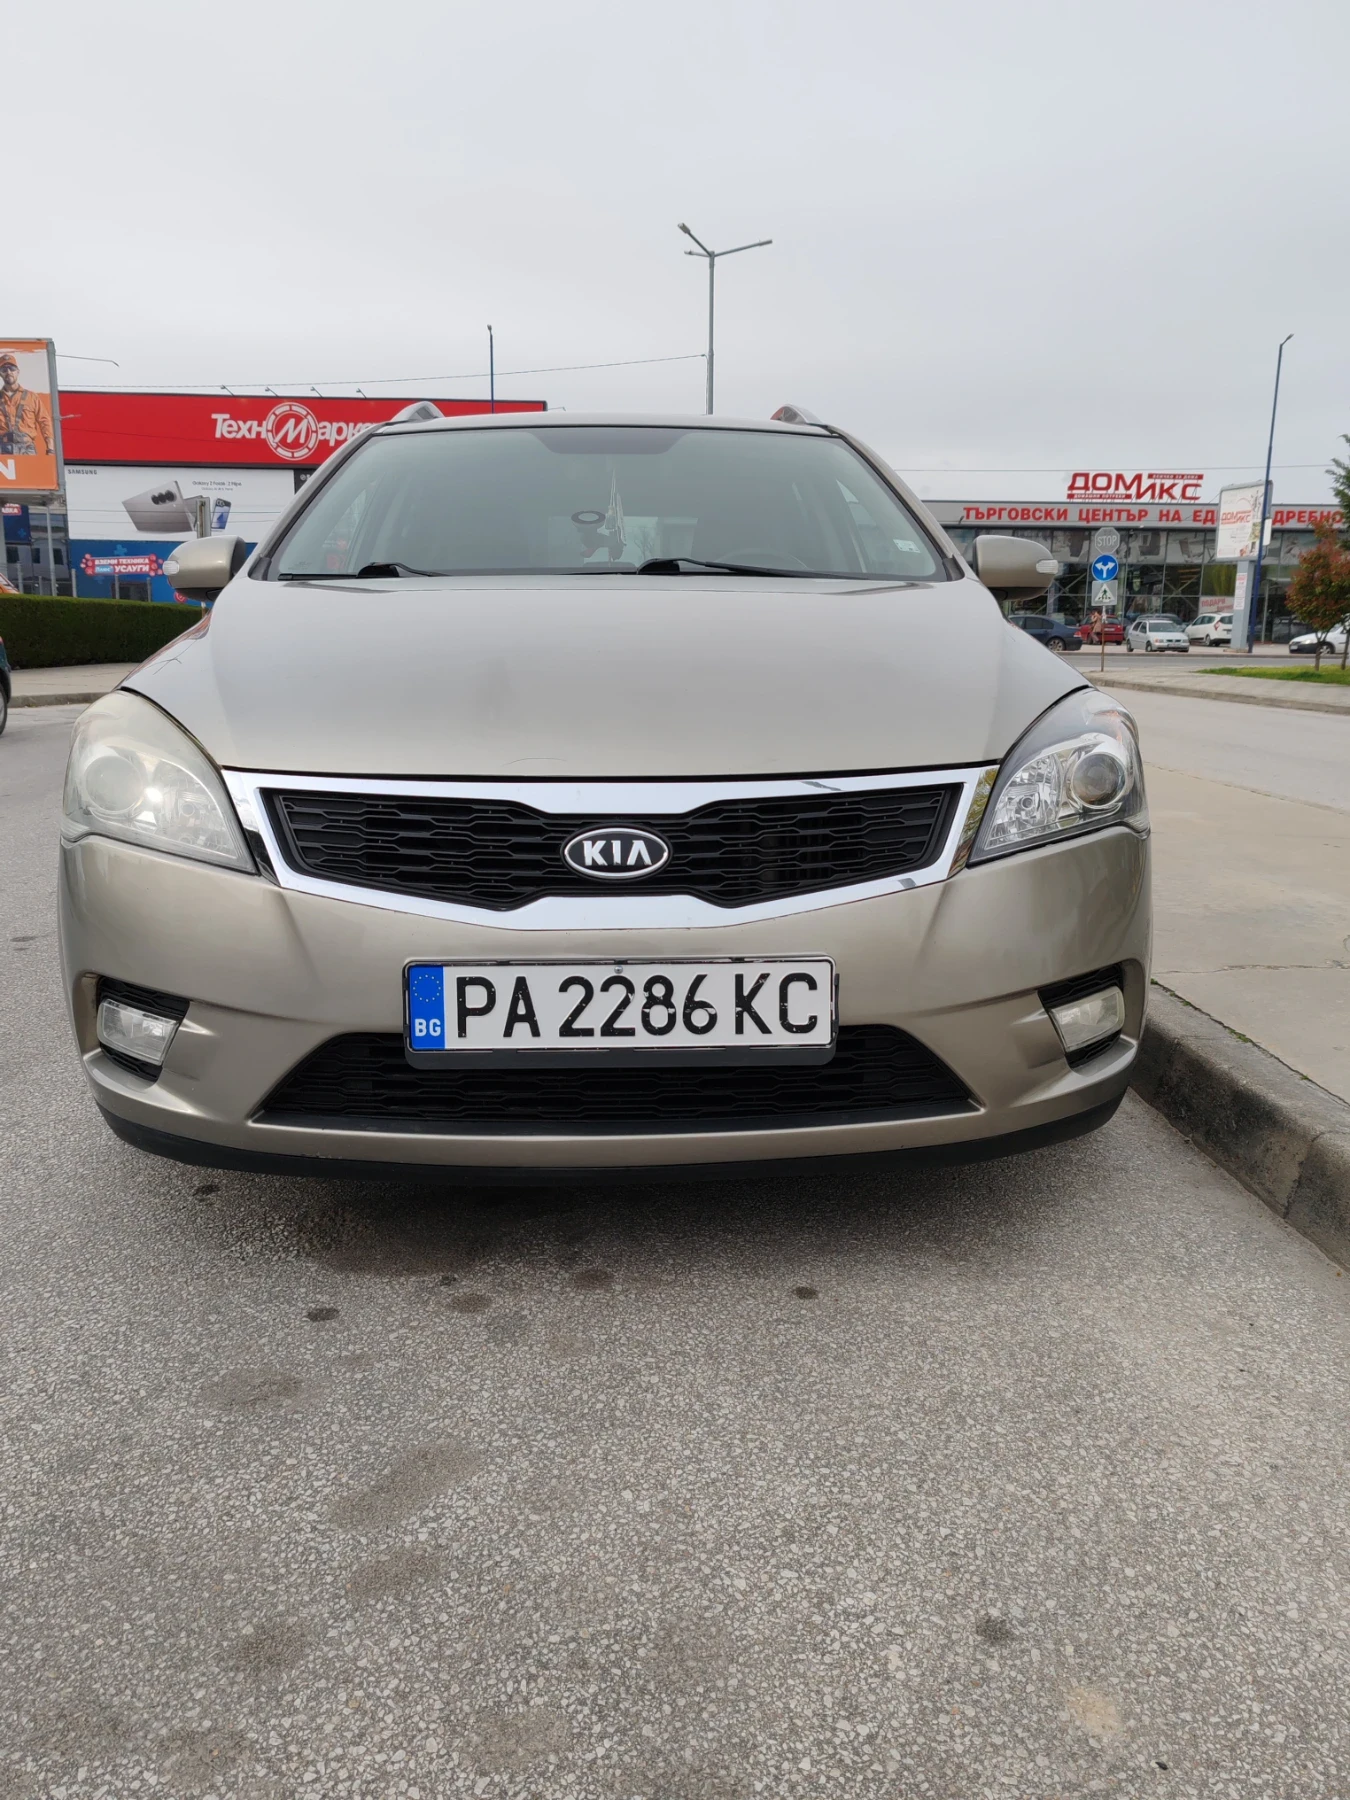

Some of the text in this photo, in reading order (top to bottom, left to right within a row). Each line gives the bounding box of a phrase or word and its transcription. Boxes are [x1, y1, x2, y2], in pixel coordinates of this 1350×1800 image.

[1067, 472, 1203, 501] ДОМИКС
[963, 507, 1344, 525] ТЪРГОВСКИ ЦЕНТЪР НА ЕД ДРЕБНО
[1097, 535, 1117, 547] STOP
[114, 564, 150, 573] УСЛУГИ
[582, 840, 653, 866] KIA
[558, 974, 719, 1037] 2286
[414, 1019, 442, 1036] BG
